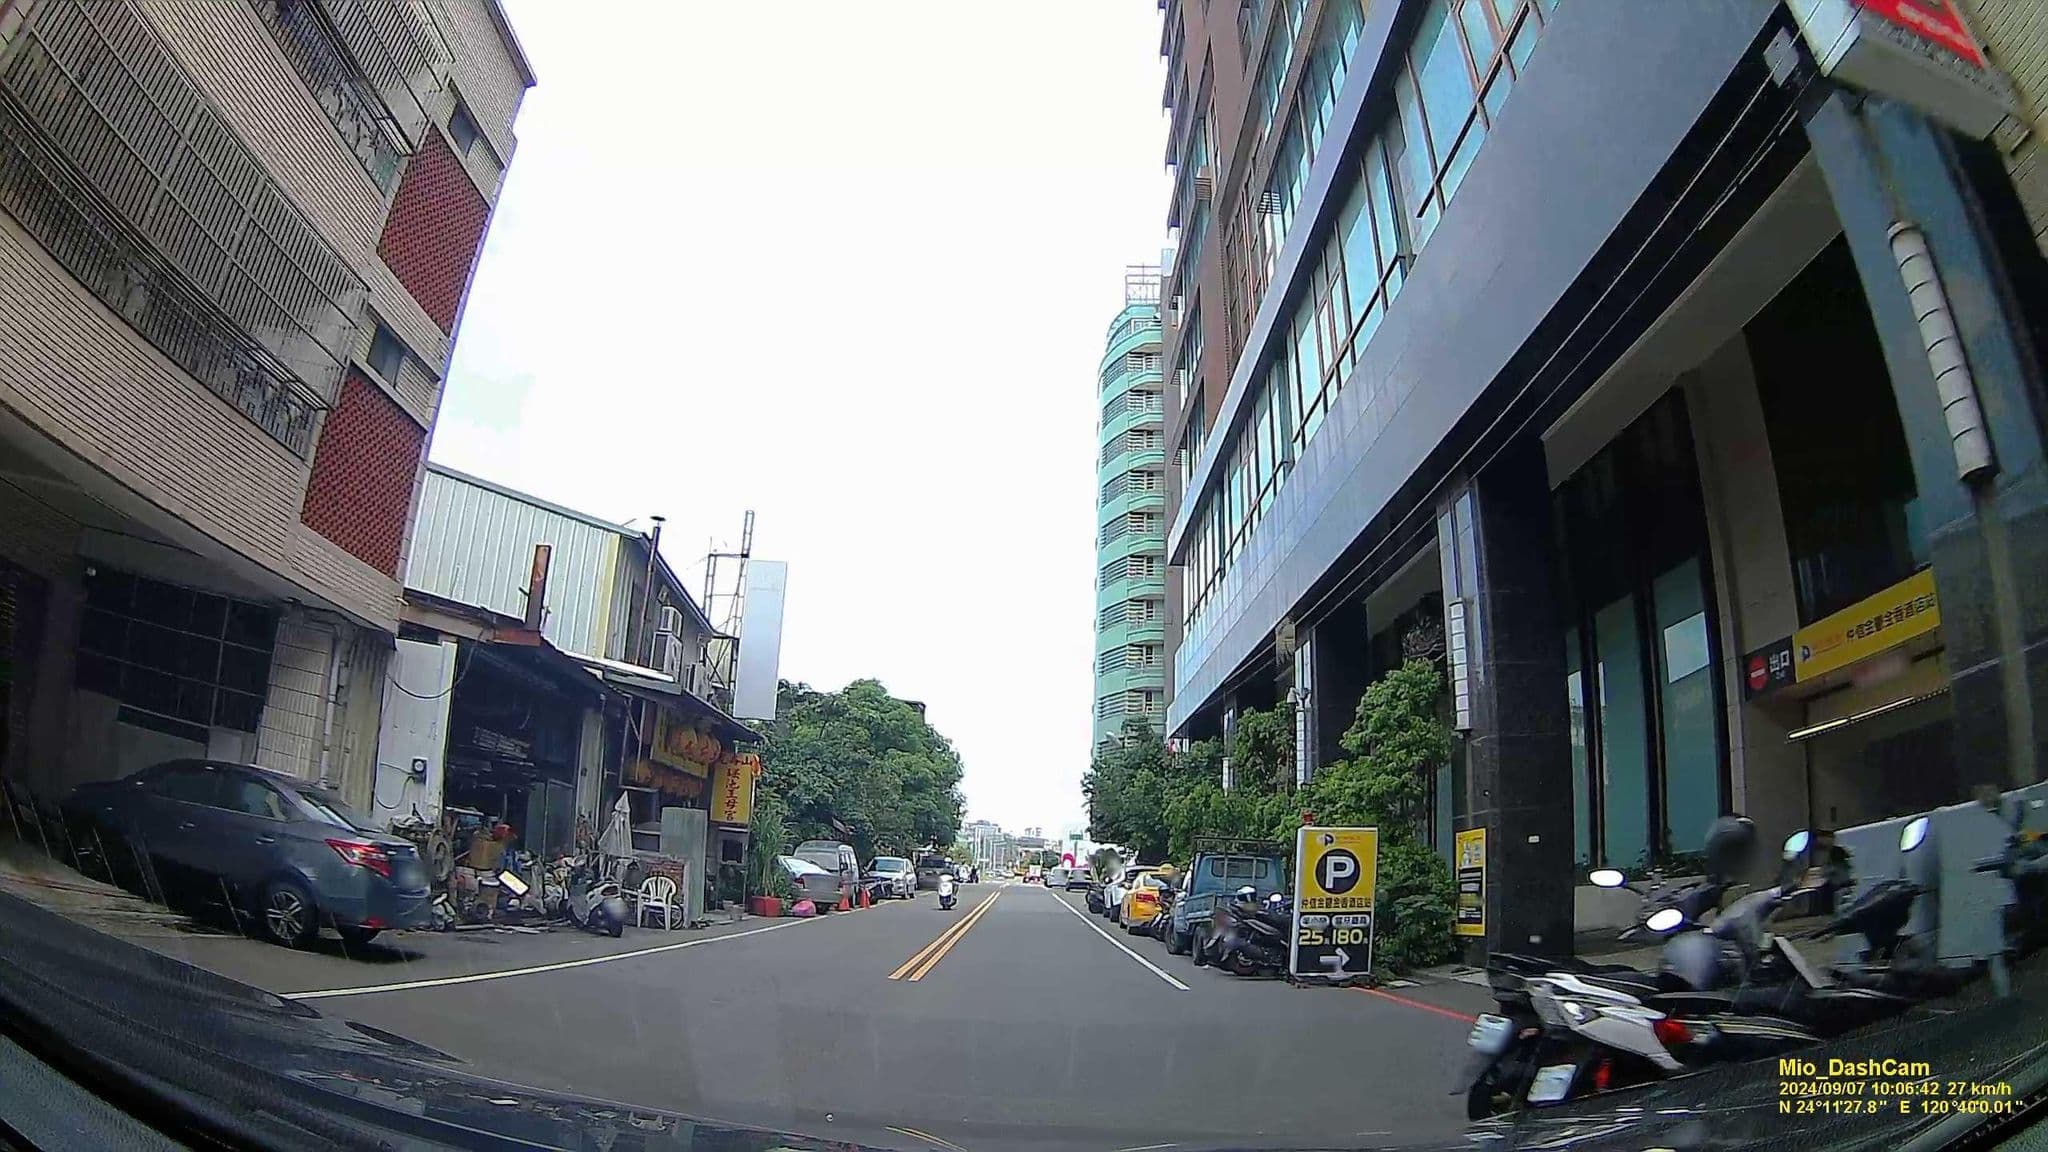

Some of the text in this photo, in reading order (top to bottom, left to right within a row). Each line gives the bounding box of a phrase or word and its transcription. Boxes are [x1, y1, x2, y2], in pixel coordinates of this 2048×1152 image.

[1769, 649, 1790, 673] 出口
[1325, 855, 1355, 889] P
[1299, 928, 1324, 946] 25
[1332, 928, 1363, 946] 180
